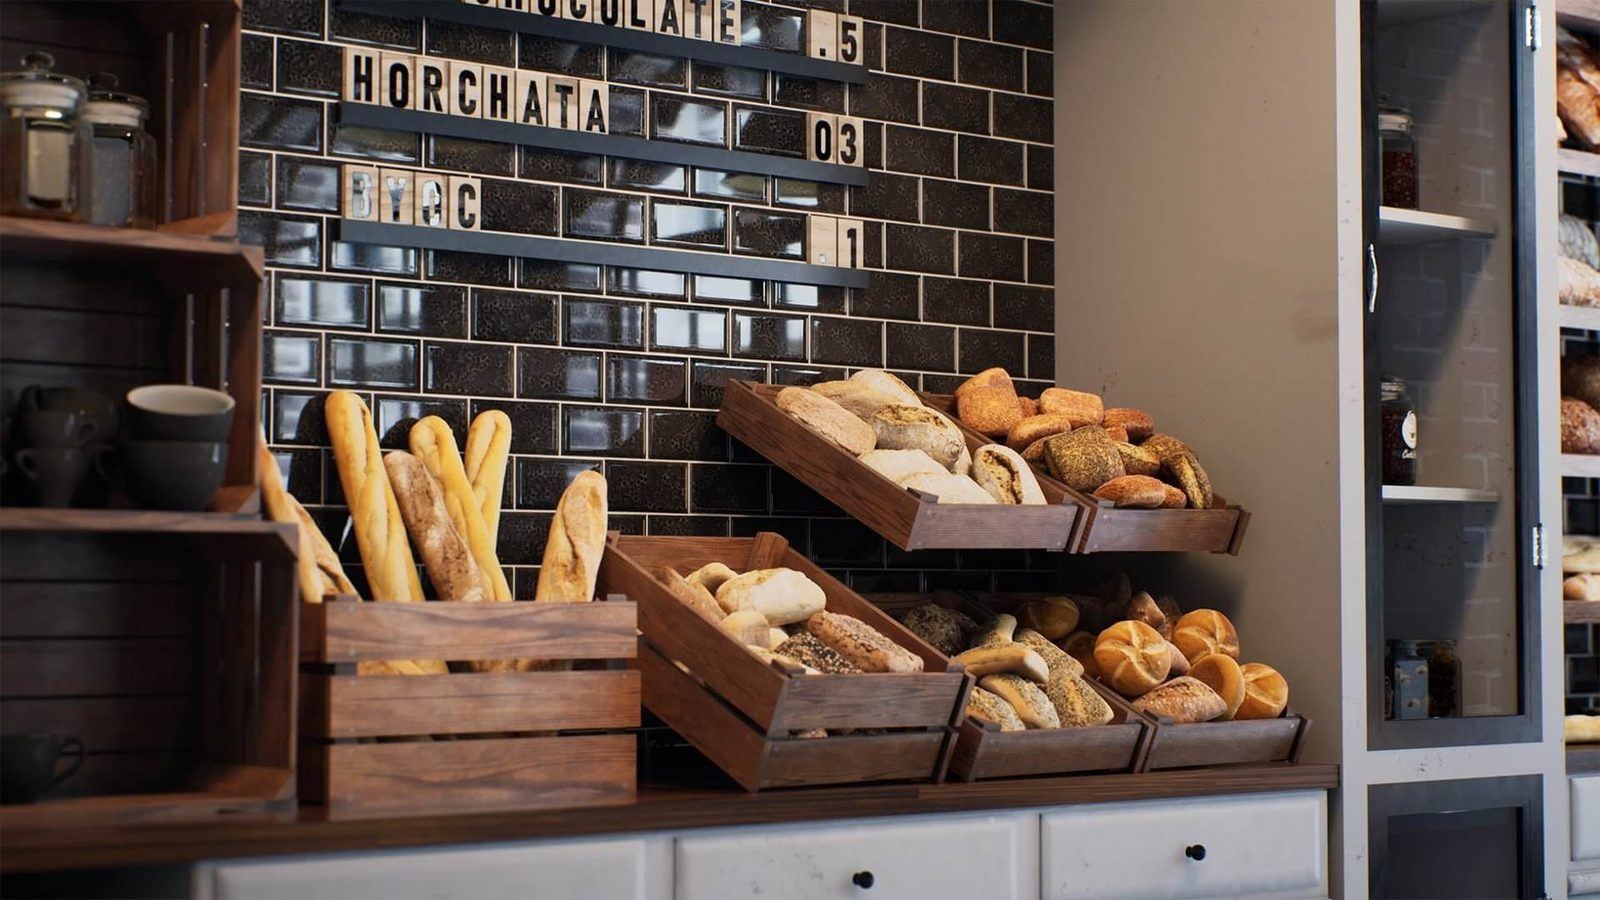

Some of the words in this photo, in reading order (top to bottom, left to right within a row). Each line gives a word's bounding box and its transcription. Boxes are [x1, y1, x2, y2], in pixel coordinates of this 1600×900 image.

[476, 0, 735, 43] OLATE
[354, 55, 605, 133] HORCHATA
[815, 120, 857, 164] 03
